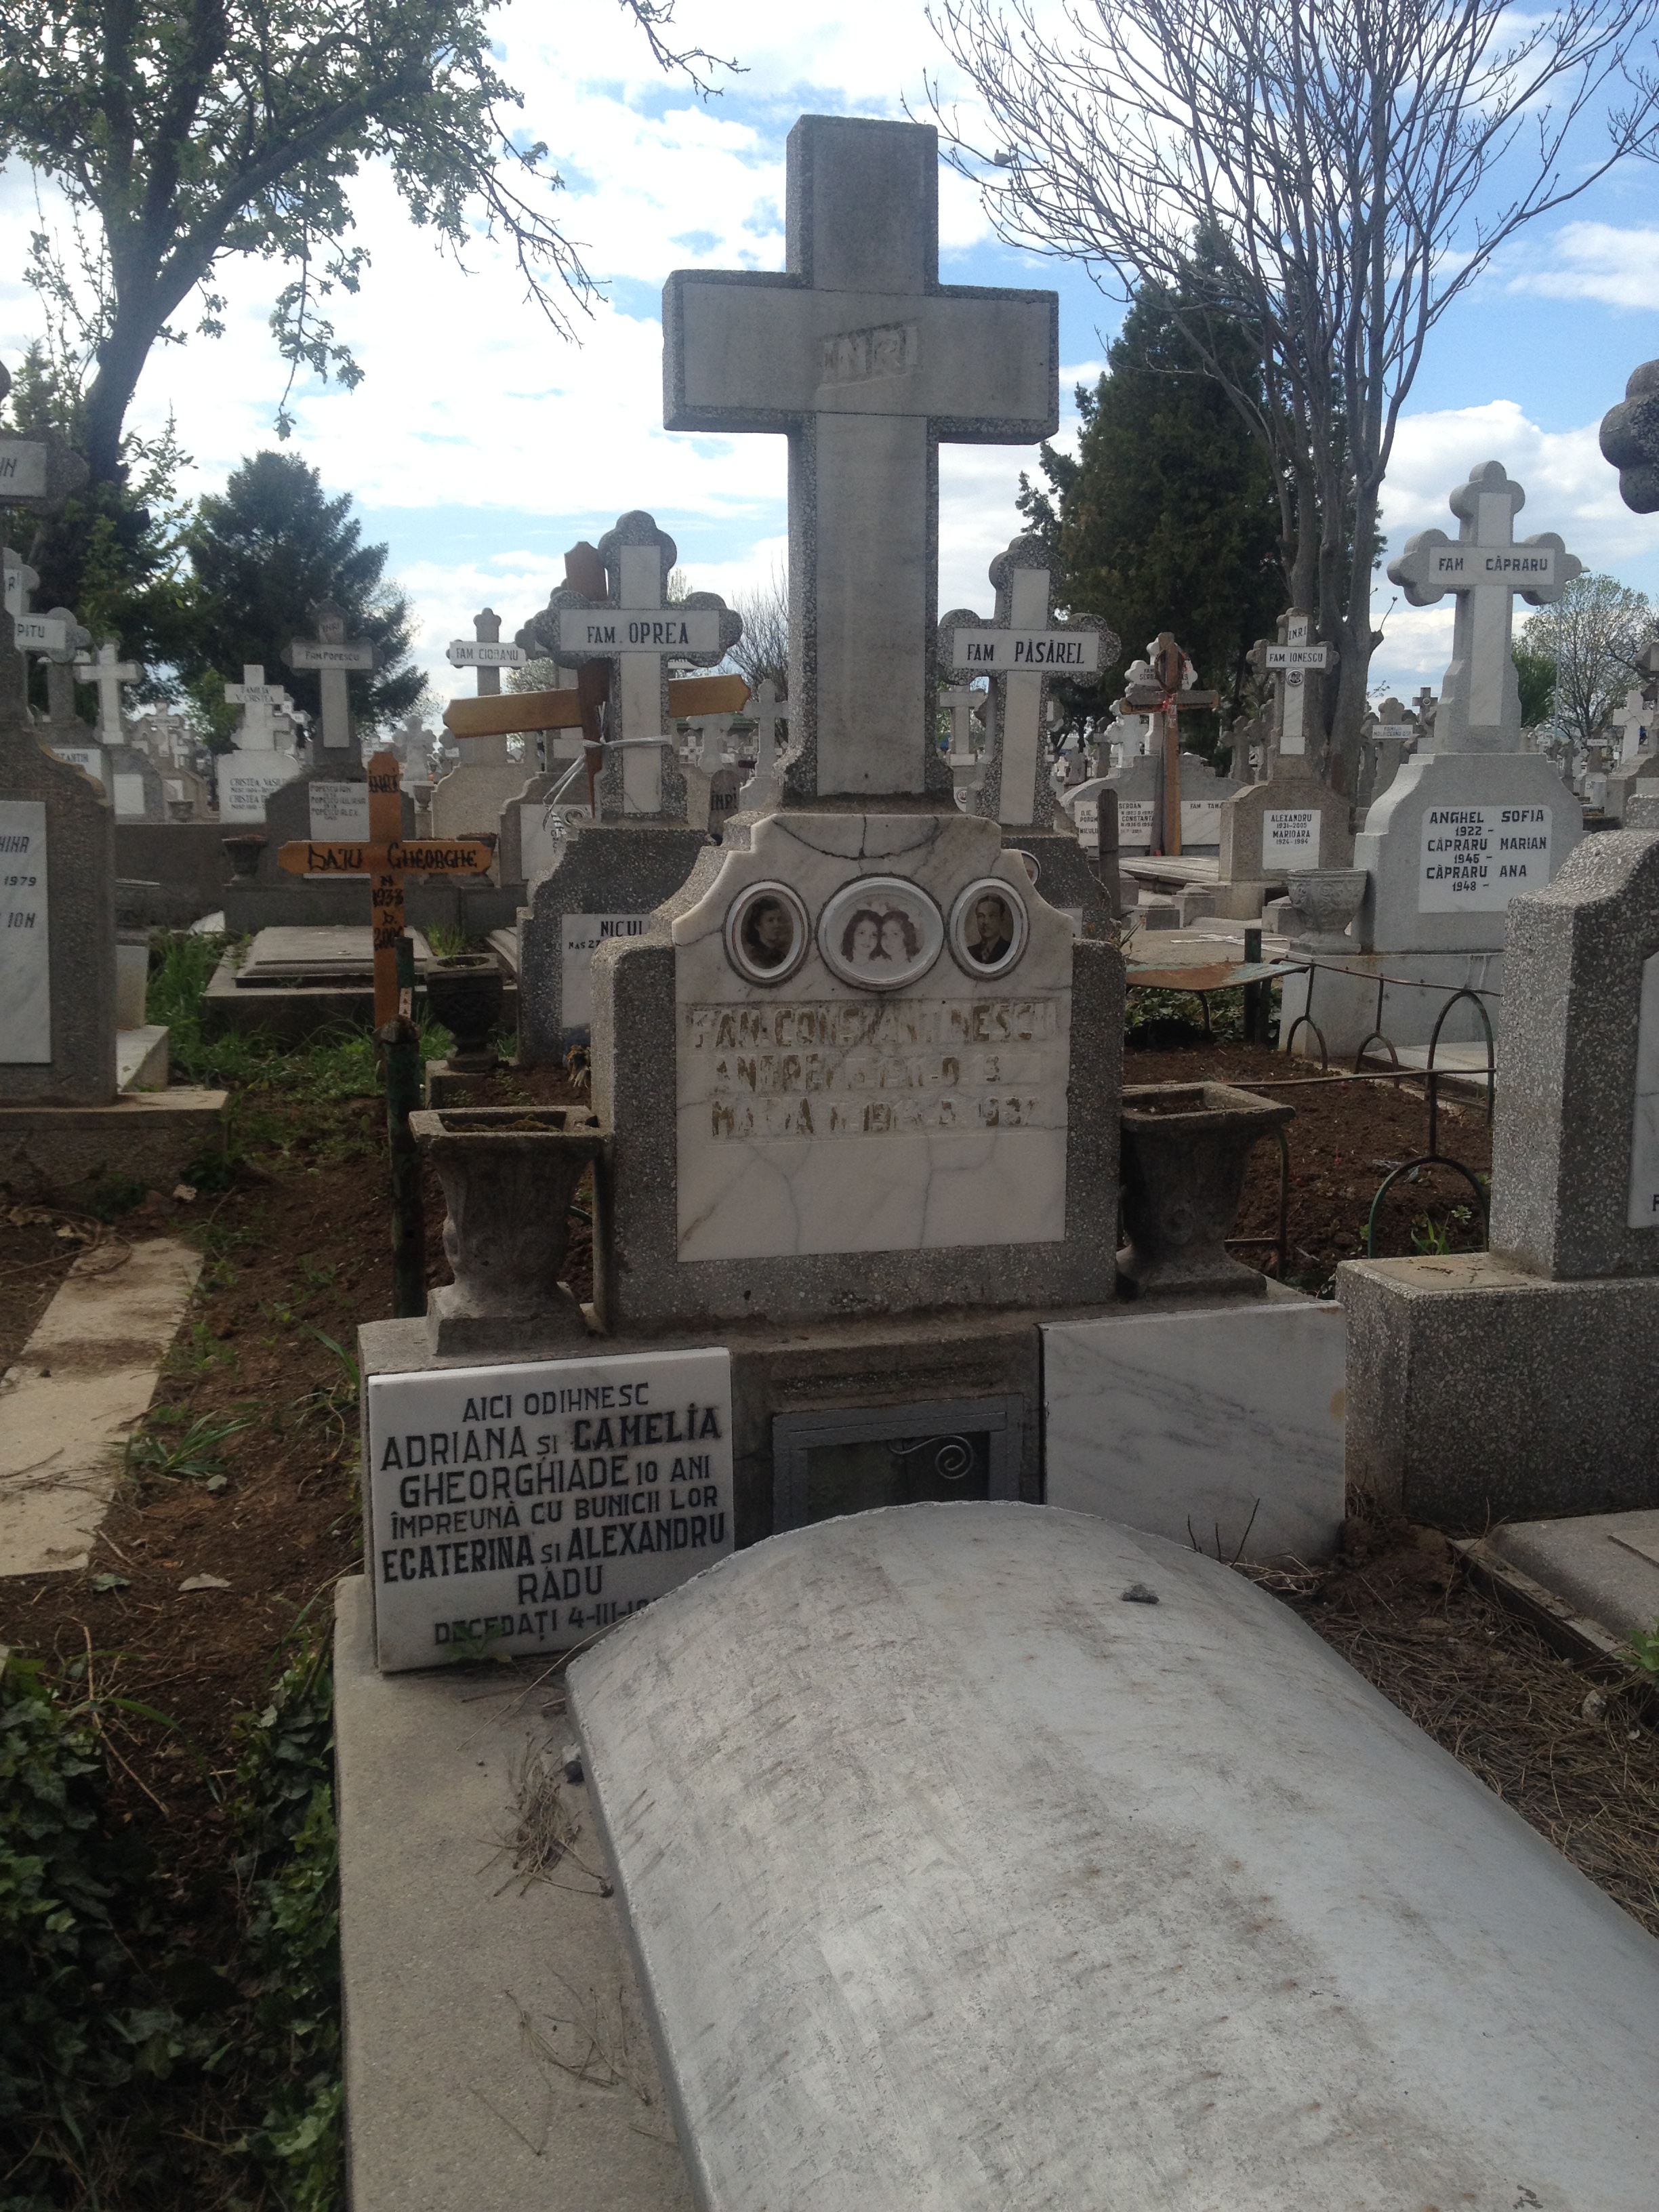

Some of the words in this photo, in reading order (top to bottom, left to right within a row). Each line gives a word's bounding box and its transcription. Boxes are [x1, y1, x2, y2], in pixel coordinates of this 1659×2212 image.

[1439, 558, 1464, 571] FAM
[629, 622, 689, 644] OPREA
[1288, 626, 1307, 640] INRI
[1290, 652, 1323, 662] IONESCU
[1271, 814, 1312, 822] ALEXANDRU
[1429, 811, 1484, 823] ANGHEL
[1501, 809, 1544, 823] SOFIA
[1273, 830, 1310, 838] MARIOARA
[1455, 826, 1481, 837] 1922
[1500, 836, 1547, 851] MARIAN
[1499, 865, 1527, 878] ANA
[4, 876, 37, 886] 1979
[1452, 881, 1477, 892] 1948
[462, 1394, 512, 1422] AICI
[524, 1382, 649, 1416] ODIHNESC
[380, 1425, 527, 1471] ADRIANA
[399, 1455, 629, 1509] GHEORGHIADE
[636, 1460, 657, 1486] 10
[670, 1455, 710, 1483] ANI
[531, 1500, 562, 1525] CU
[575, 1490, 660, 1521] BUNICII
[670, 1486, 718, 1511] LOR
[382, 1534, 535, 1584] ECATERINA
[567, 1512, 725, 1562] ALEXANDRU
[518, 1565, 603, 1605] RADU
